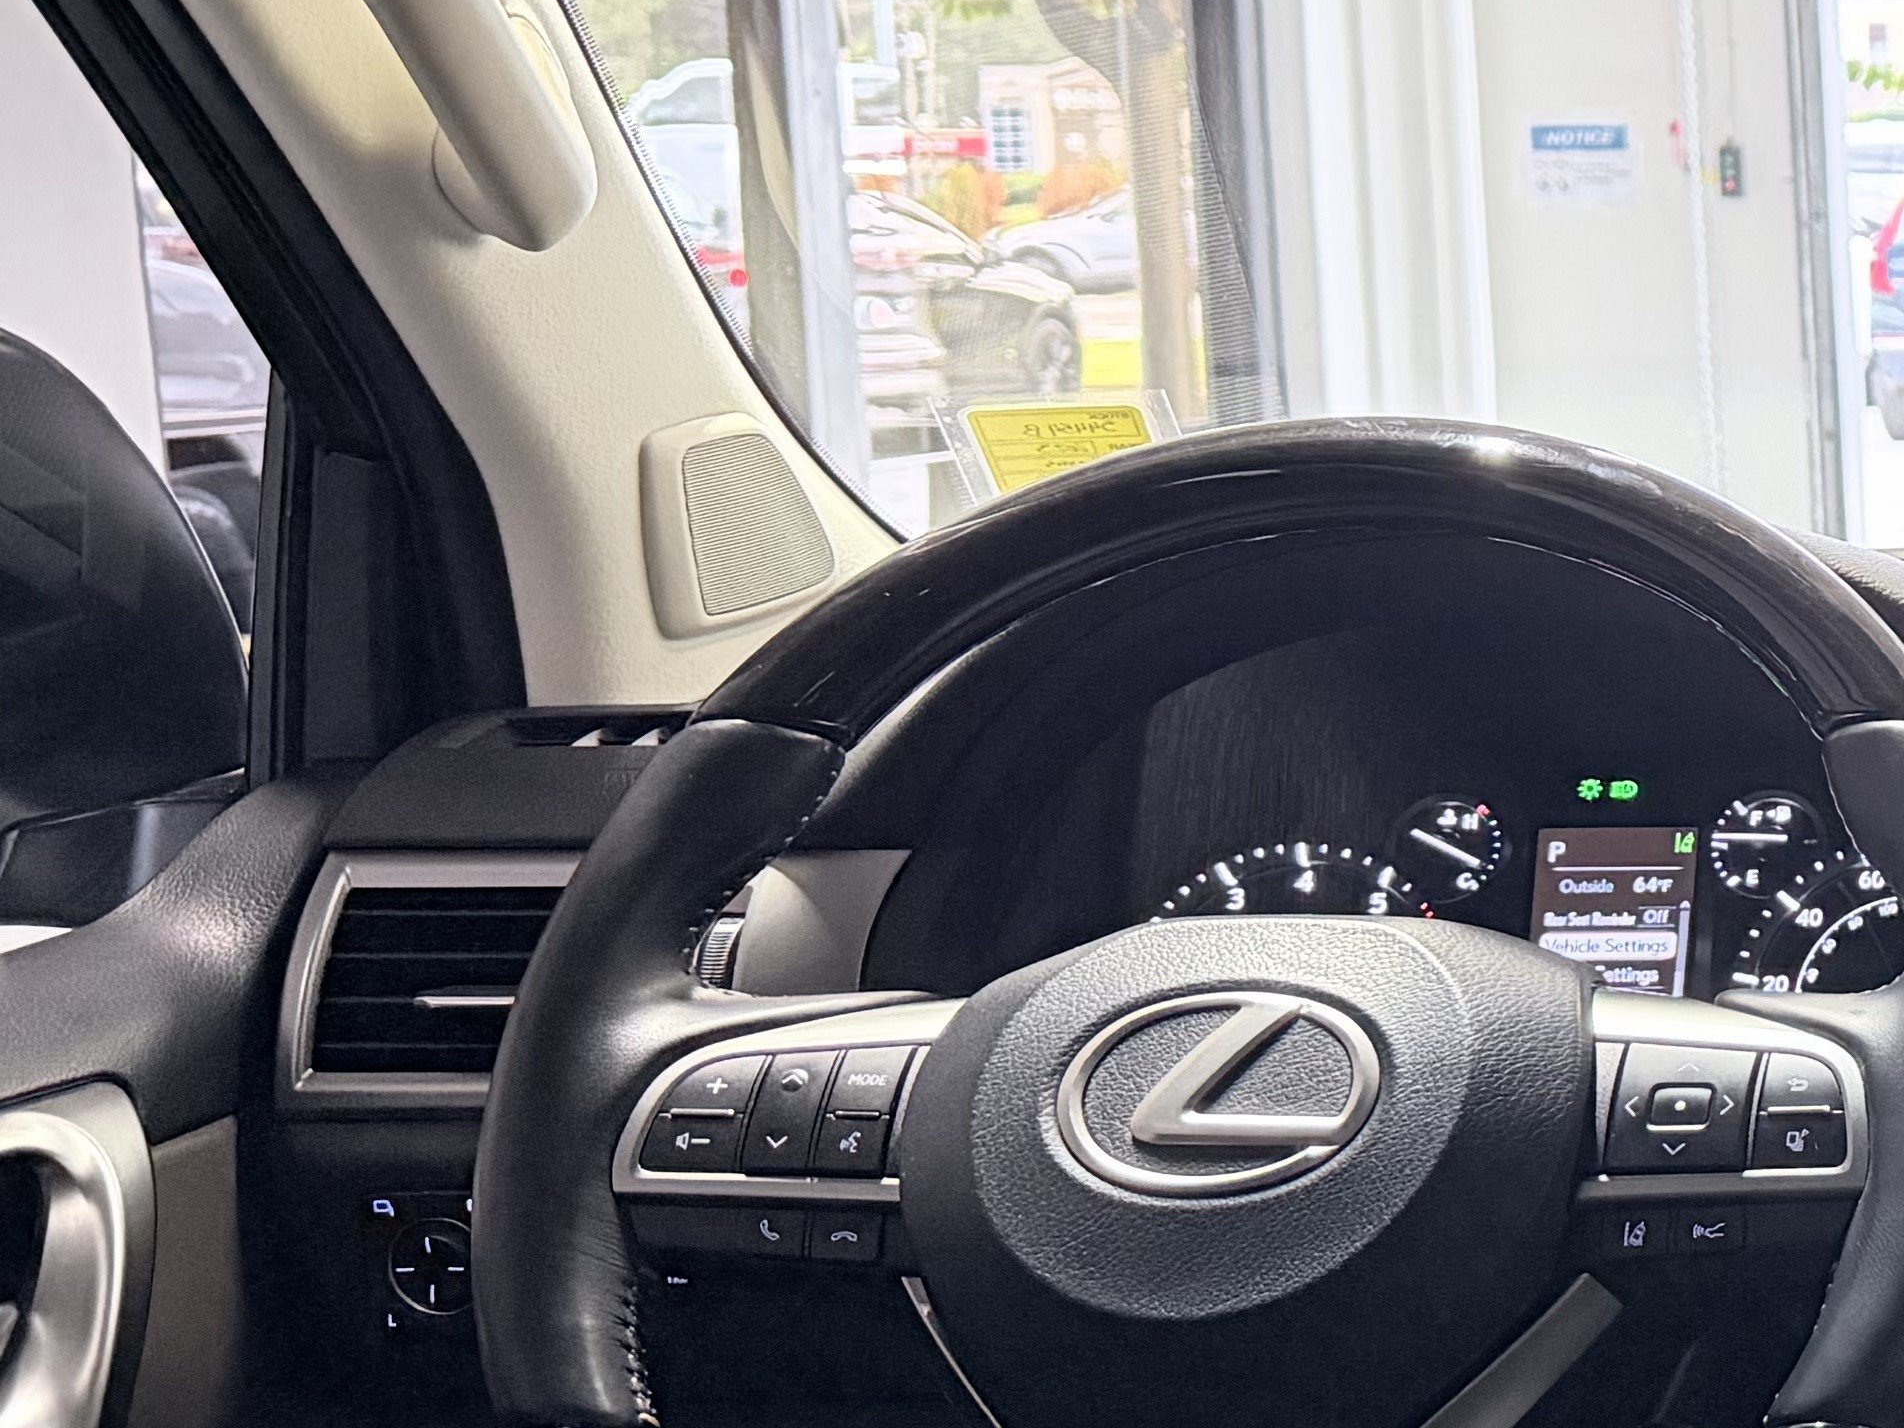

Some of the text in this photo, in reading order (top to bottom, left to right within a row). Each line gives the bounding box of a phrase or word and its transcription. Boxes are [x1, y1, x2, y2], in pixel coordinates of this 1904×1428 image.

[1750, 810, 1763, 826] F
[1547, 841, 1566, 863] P
[1293, 870, 1315, 894] 4
[1559, 878, 1615, 894] Outside
[1746, 869, 1759, 887] E
[1859, 870, 1886, 890] 60
[1225, 887, 1245, 910] 3
[1367, 891, 1388, 914] 5
[1642, 909, 1669, 924] Off
[1795, 908, 1824, 928] 40
[1545, 938, 1669, 956] Vehicle Settings
[1762, 974, 1790, 993] 20
[847, 1072, 889, 1087] MODE
